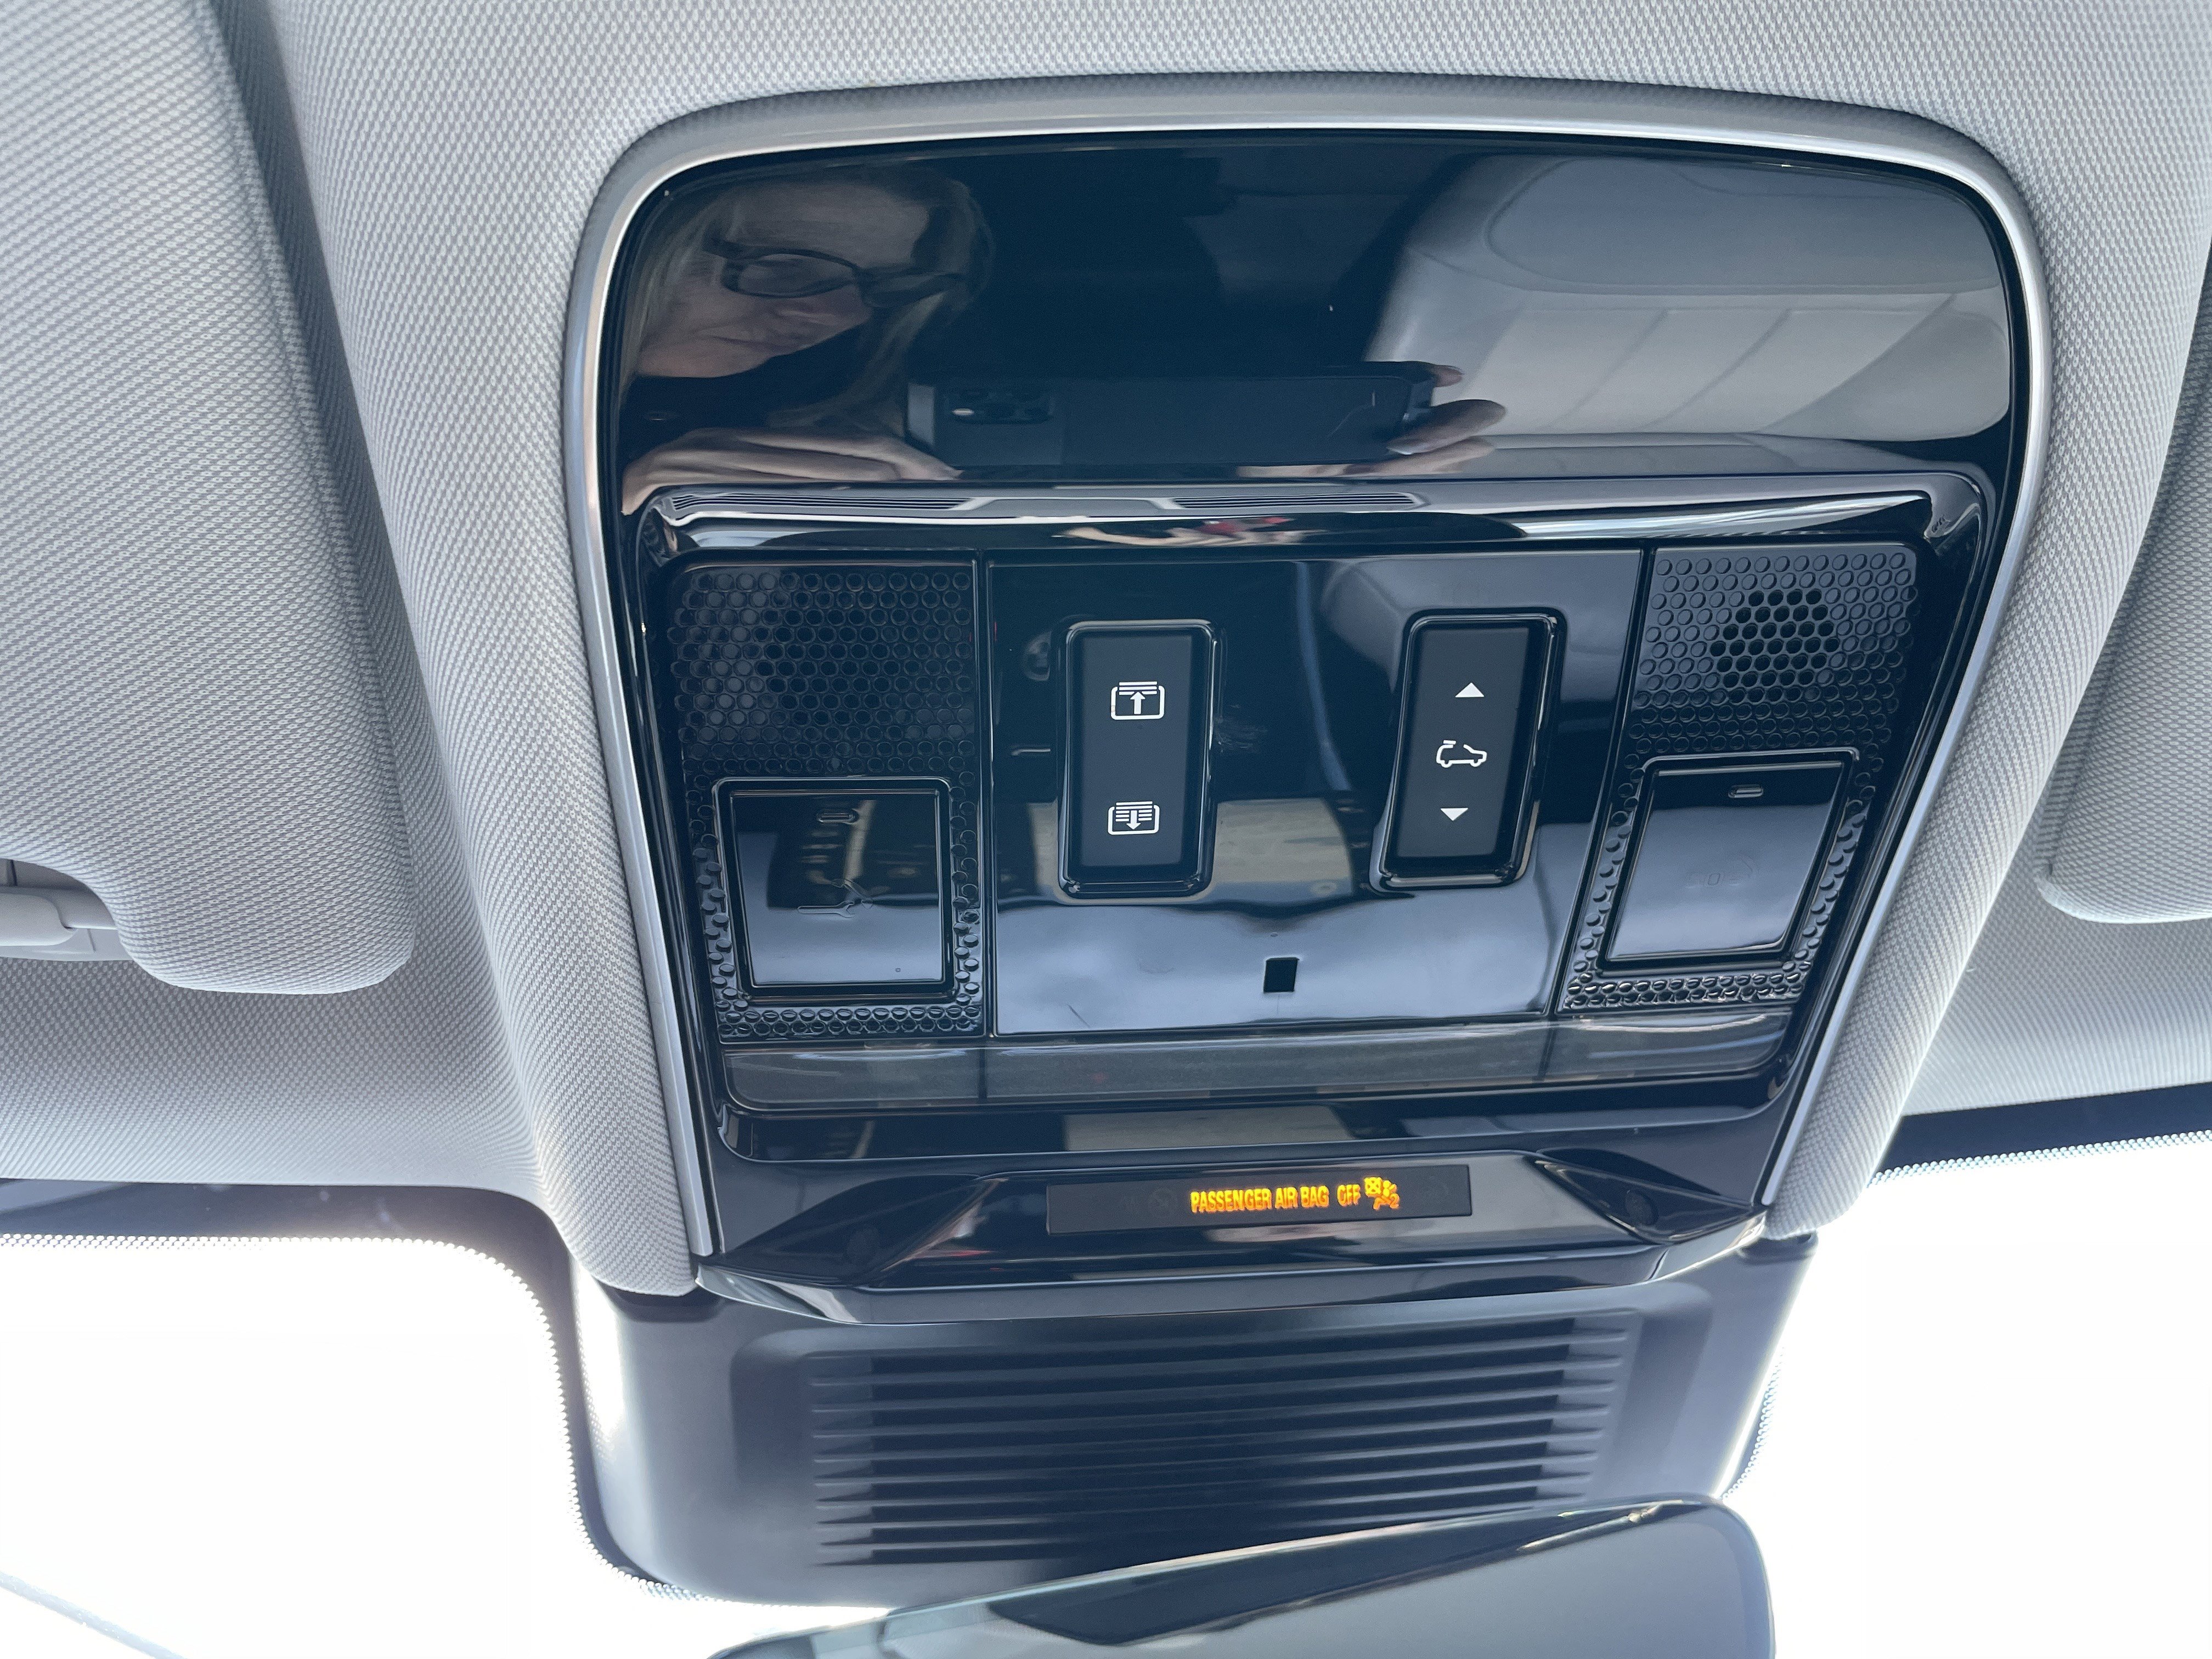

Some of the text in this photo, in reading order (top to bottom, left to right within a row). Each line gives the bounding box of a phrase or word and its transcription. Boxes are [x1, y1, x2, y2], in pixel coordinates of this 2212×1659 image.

[1190, 1188, 1272, 1213] PASSENGER
[1274, 1187, 1299, 1209] AIR
[1300, 1185, 1329, 1208] BAG
